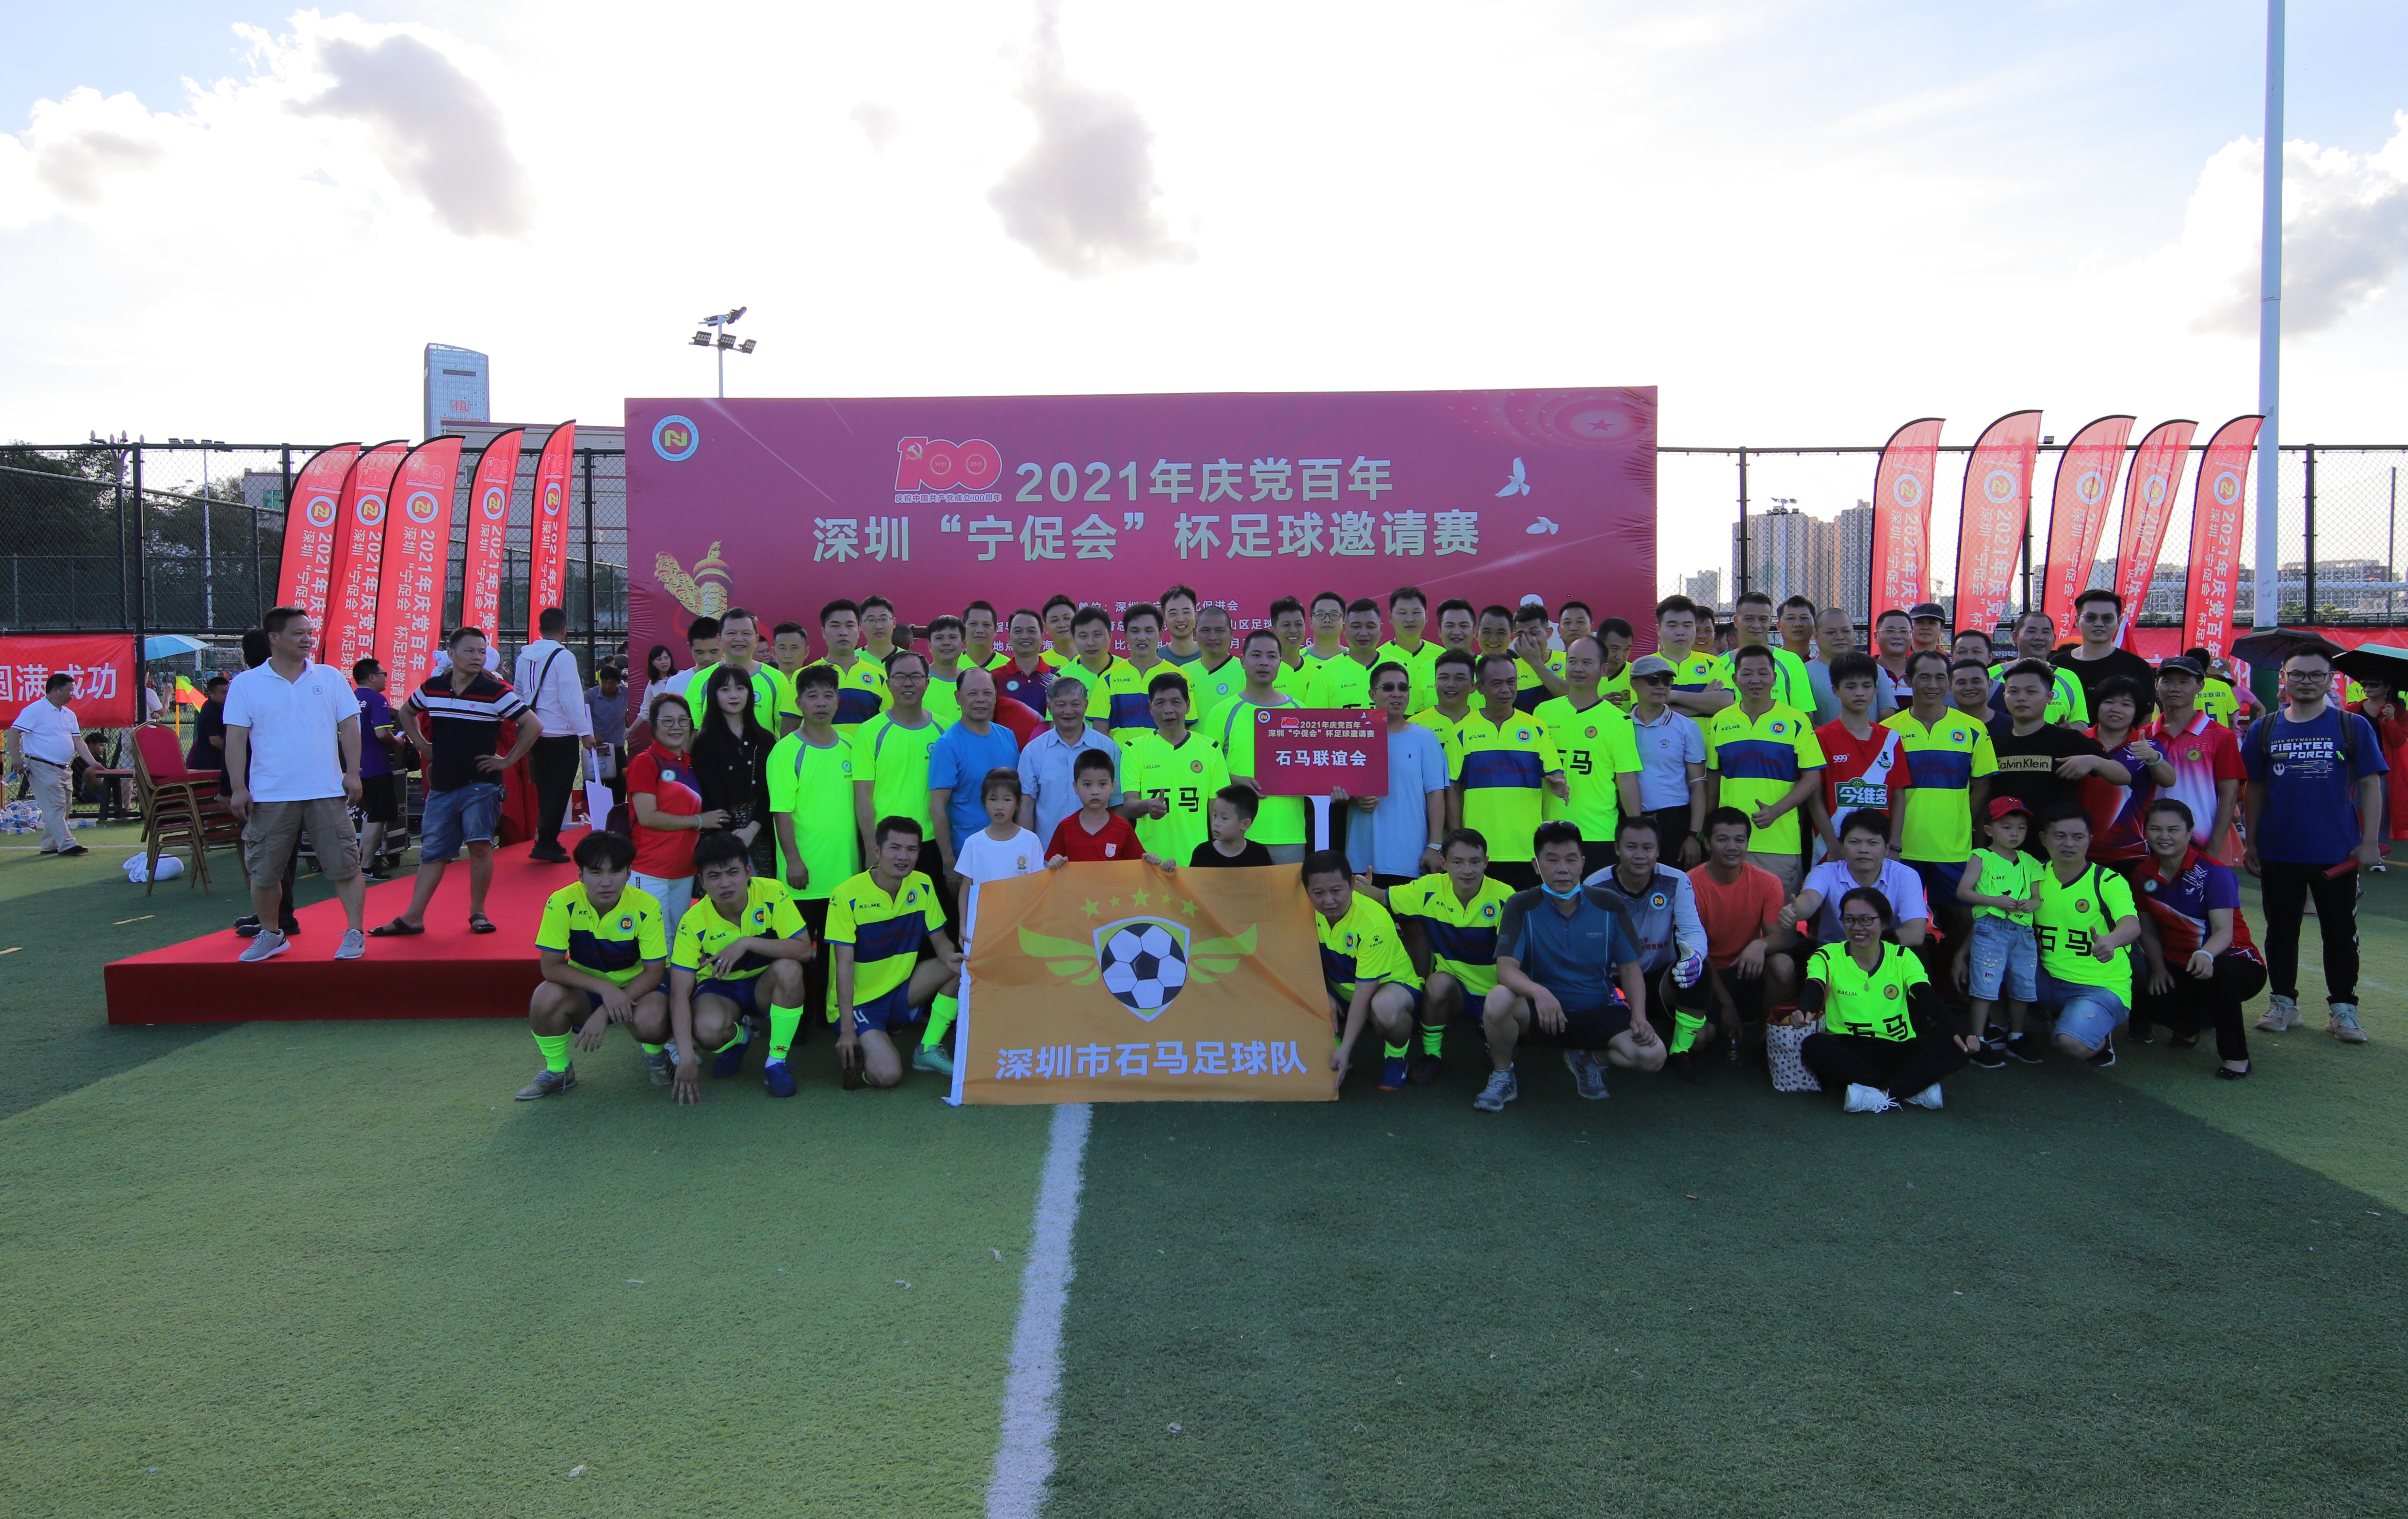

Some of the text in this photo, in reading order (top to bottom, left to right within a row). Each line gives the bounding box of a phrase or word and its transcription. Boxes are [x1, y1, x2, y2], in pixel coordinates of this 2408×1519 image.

[451, 400, 470, 411] 租
[1015, 456, 1393, 503] 2021年庆党百年
[895, 494, 1002, 503] 庆祝中国共产党成立100周年
[409, 528, 435, 670] 2021年庆党百年
[2270, 742, 2333, 753] FIGHTER
[1276, 750, 1367, 766] 石马联谊会
[1833, 754, 1848, 763] 999
[2289, 751, 2333, 759] FORCE
[2024, 758, 2048, 768] Klein
[1839, 786, 1888, 805] 今维多
[995, 1040, 1307, 1080] 深圳市石马足球队
